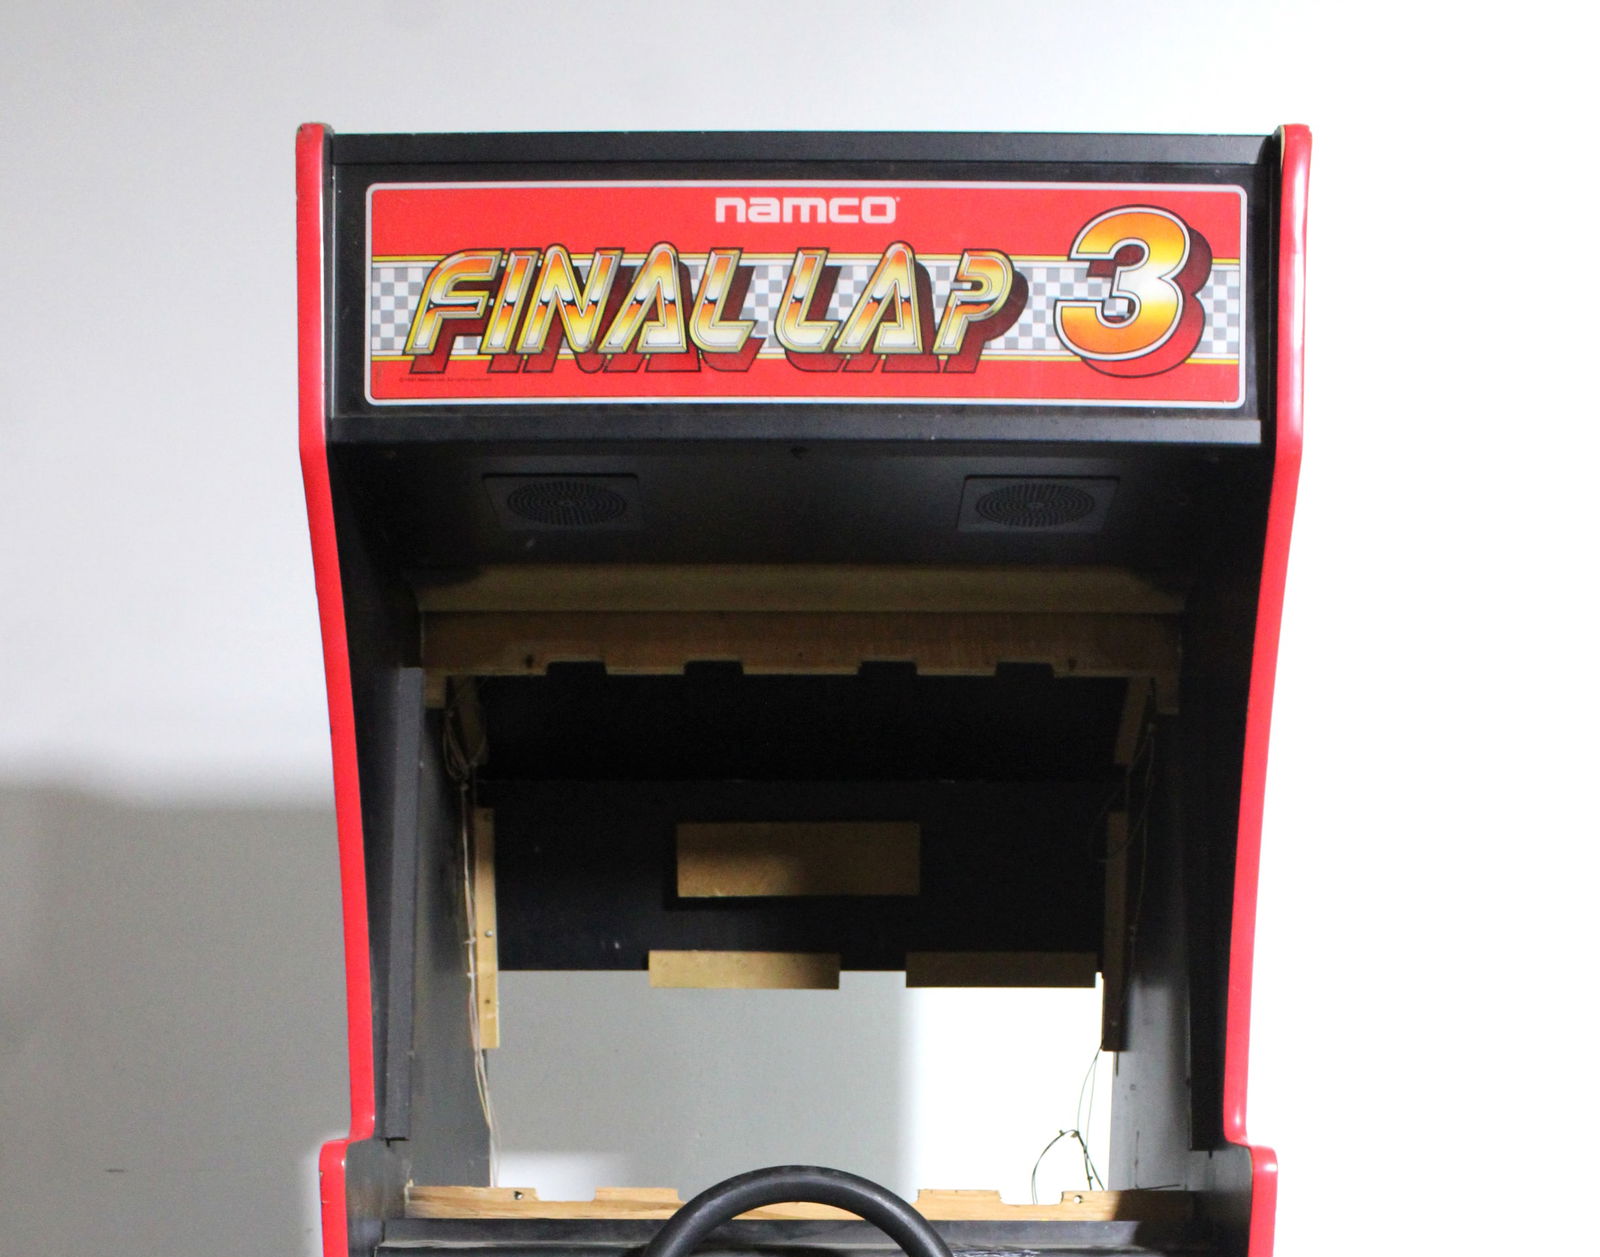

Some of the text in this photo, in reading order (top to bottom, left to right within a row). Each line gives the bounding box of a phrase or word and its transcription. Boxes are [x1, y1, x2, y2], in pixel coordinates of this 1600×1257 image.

[714, 196, 898, 225] namco
[402, 203, 1192, 362] FINAL LAP 3
